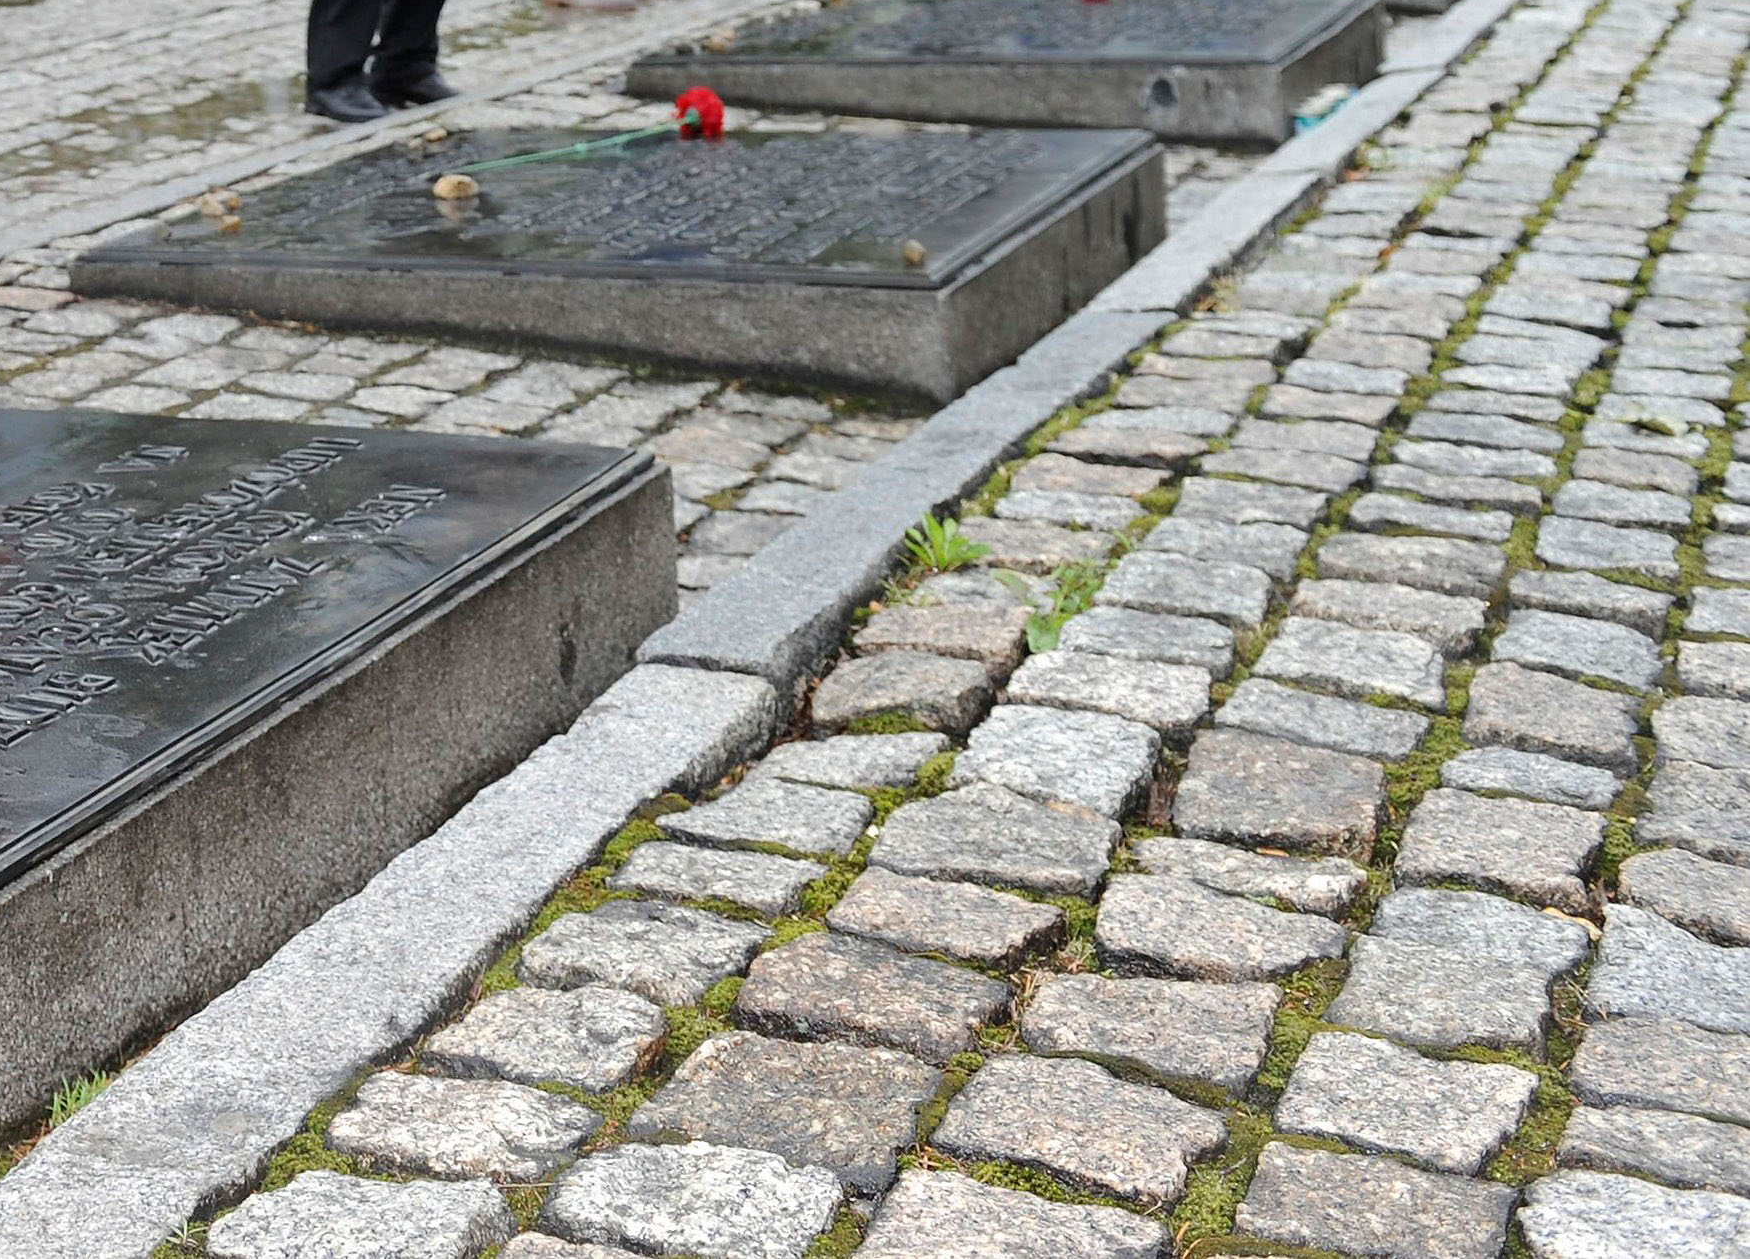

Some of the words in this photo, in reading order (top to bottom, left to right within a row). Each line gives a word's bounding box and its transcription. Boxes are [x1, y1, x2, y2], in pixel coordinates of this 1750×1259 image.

[94, 444, 188, 474] NA
[13, 508, 132, 558] OVO
[300, 484, 446, 546] NEKA
[116, 510, 319, 593] KRIKOM
[88, 556, 330, 667] ZAUVIJEK
